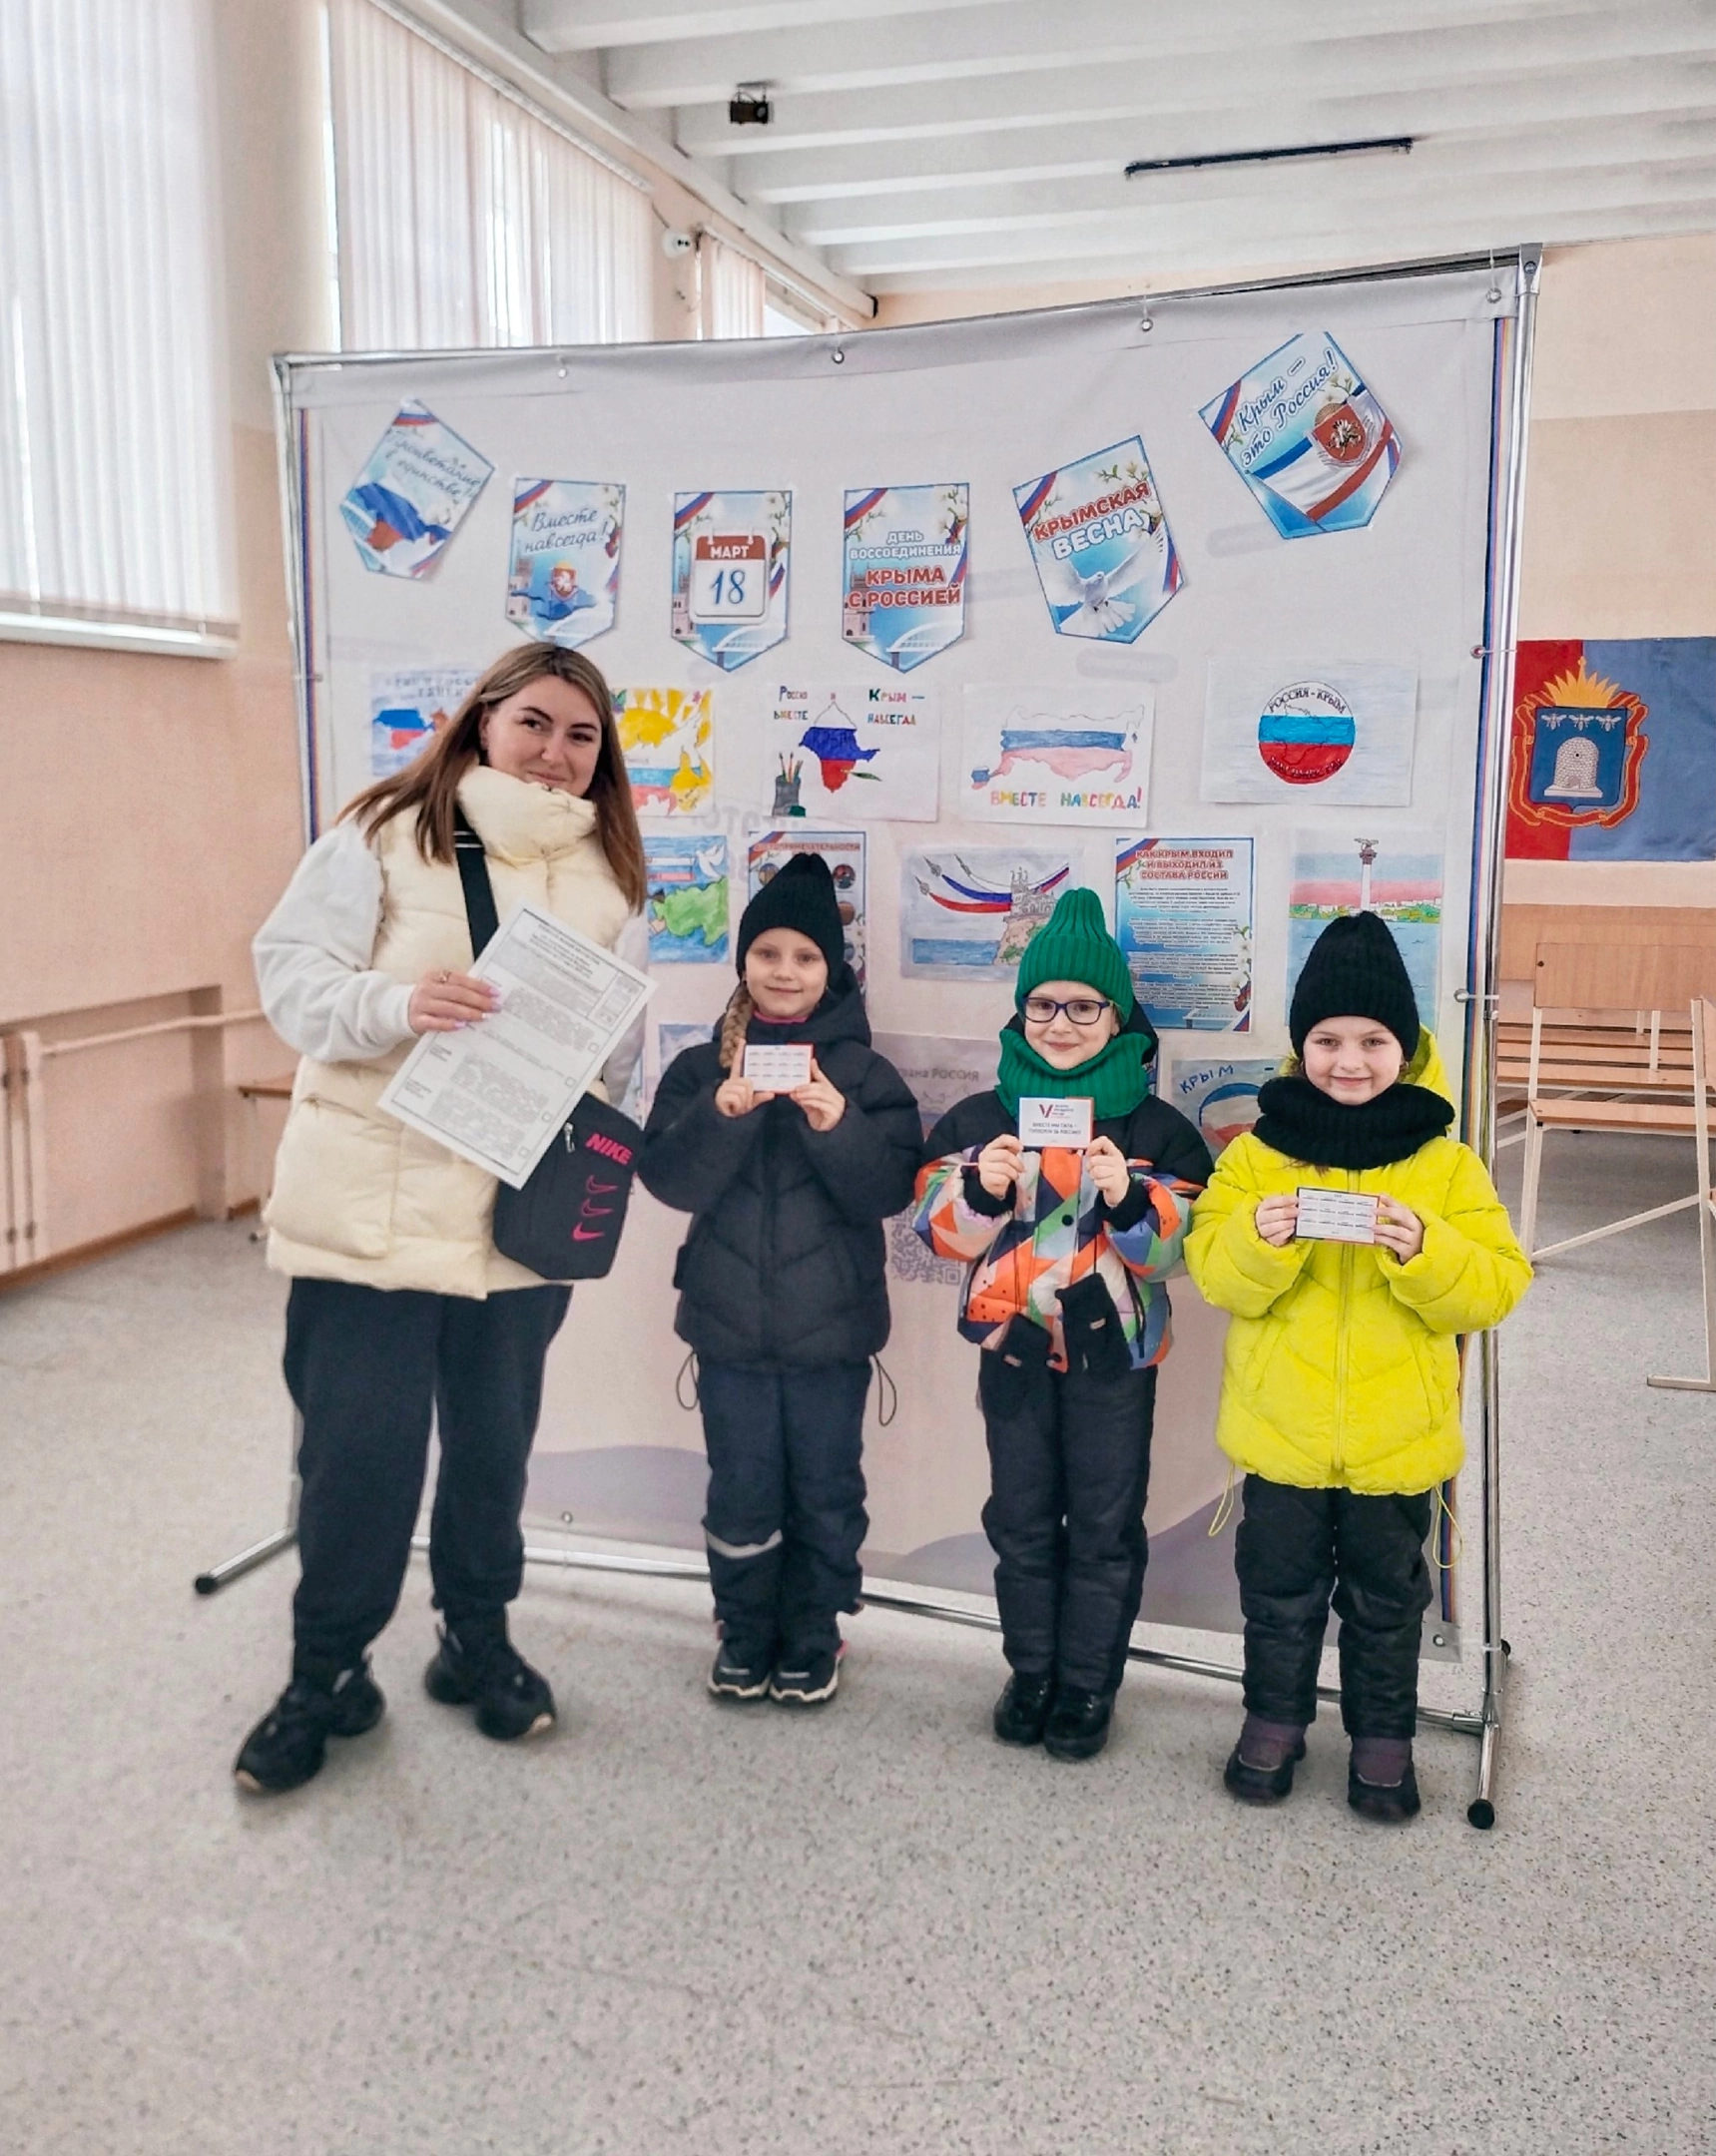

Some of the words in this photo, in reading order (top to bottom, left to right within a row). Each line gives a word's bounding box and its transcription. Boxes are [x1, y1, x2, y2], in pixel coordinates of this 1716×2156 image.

[1240, 378, 1286, 432] Крым
[1243, 429, 1272, 466] это
[1273, 349, 1337, 429] Россия!
[532, 507, 598, 532] Вместе
[1034, 482, 1151, 543] КРЫМСКАЯ
[886, 531, 924, 545] ДЕНЬ
[1052, 508, 1144, 561] ВЕСНА
[710, 545, 750, 559] МАРТ
[850, 544, 962, 559] ВОССОЕДИНЕНИЯ
[711, 569, 747, 605] 18
[866, 566, 946, 587] КРЫМА
[850, 592, 861, 608] С
[867, 583, 961, 608] РОССИЕЙ
[1267, 687, 1311, 714] РОССИЯ
[1317, 688, 1347, 715] КРЫМ
[990, 791, 1047, 808] ВМЕСТЕ
[1060, 787, 1142, 809] НАВСЕГДА!
[1137, 849, 1157, 858] КАК
[1158, 849, 1189, 858] КРЫМ
[1192, 849, 1233, 858] ВХОДИЛ
[1141, 870, 1185, 879] СОСТАВА
[1188, 870, 1228, 879] РОССИИ
[931, 1068, 980, 1082] РОССИЯ
[1180, 1065, 1233, 1094] КРЫМ
[586, 1132, 633, 1166] NIKE
